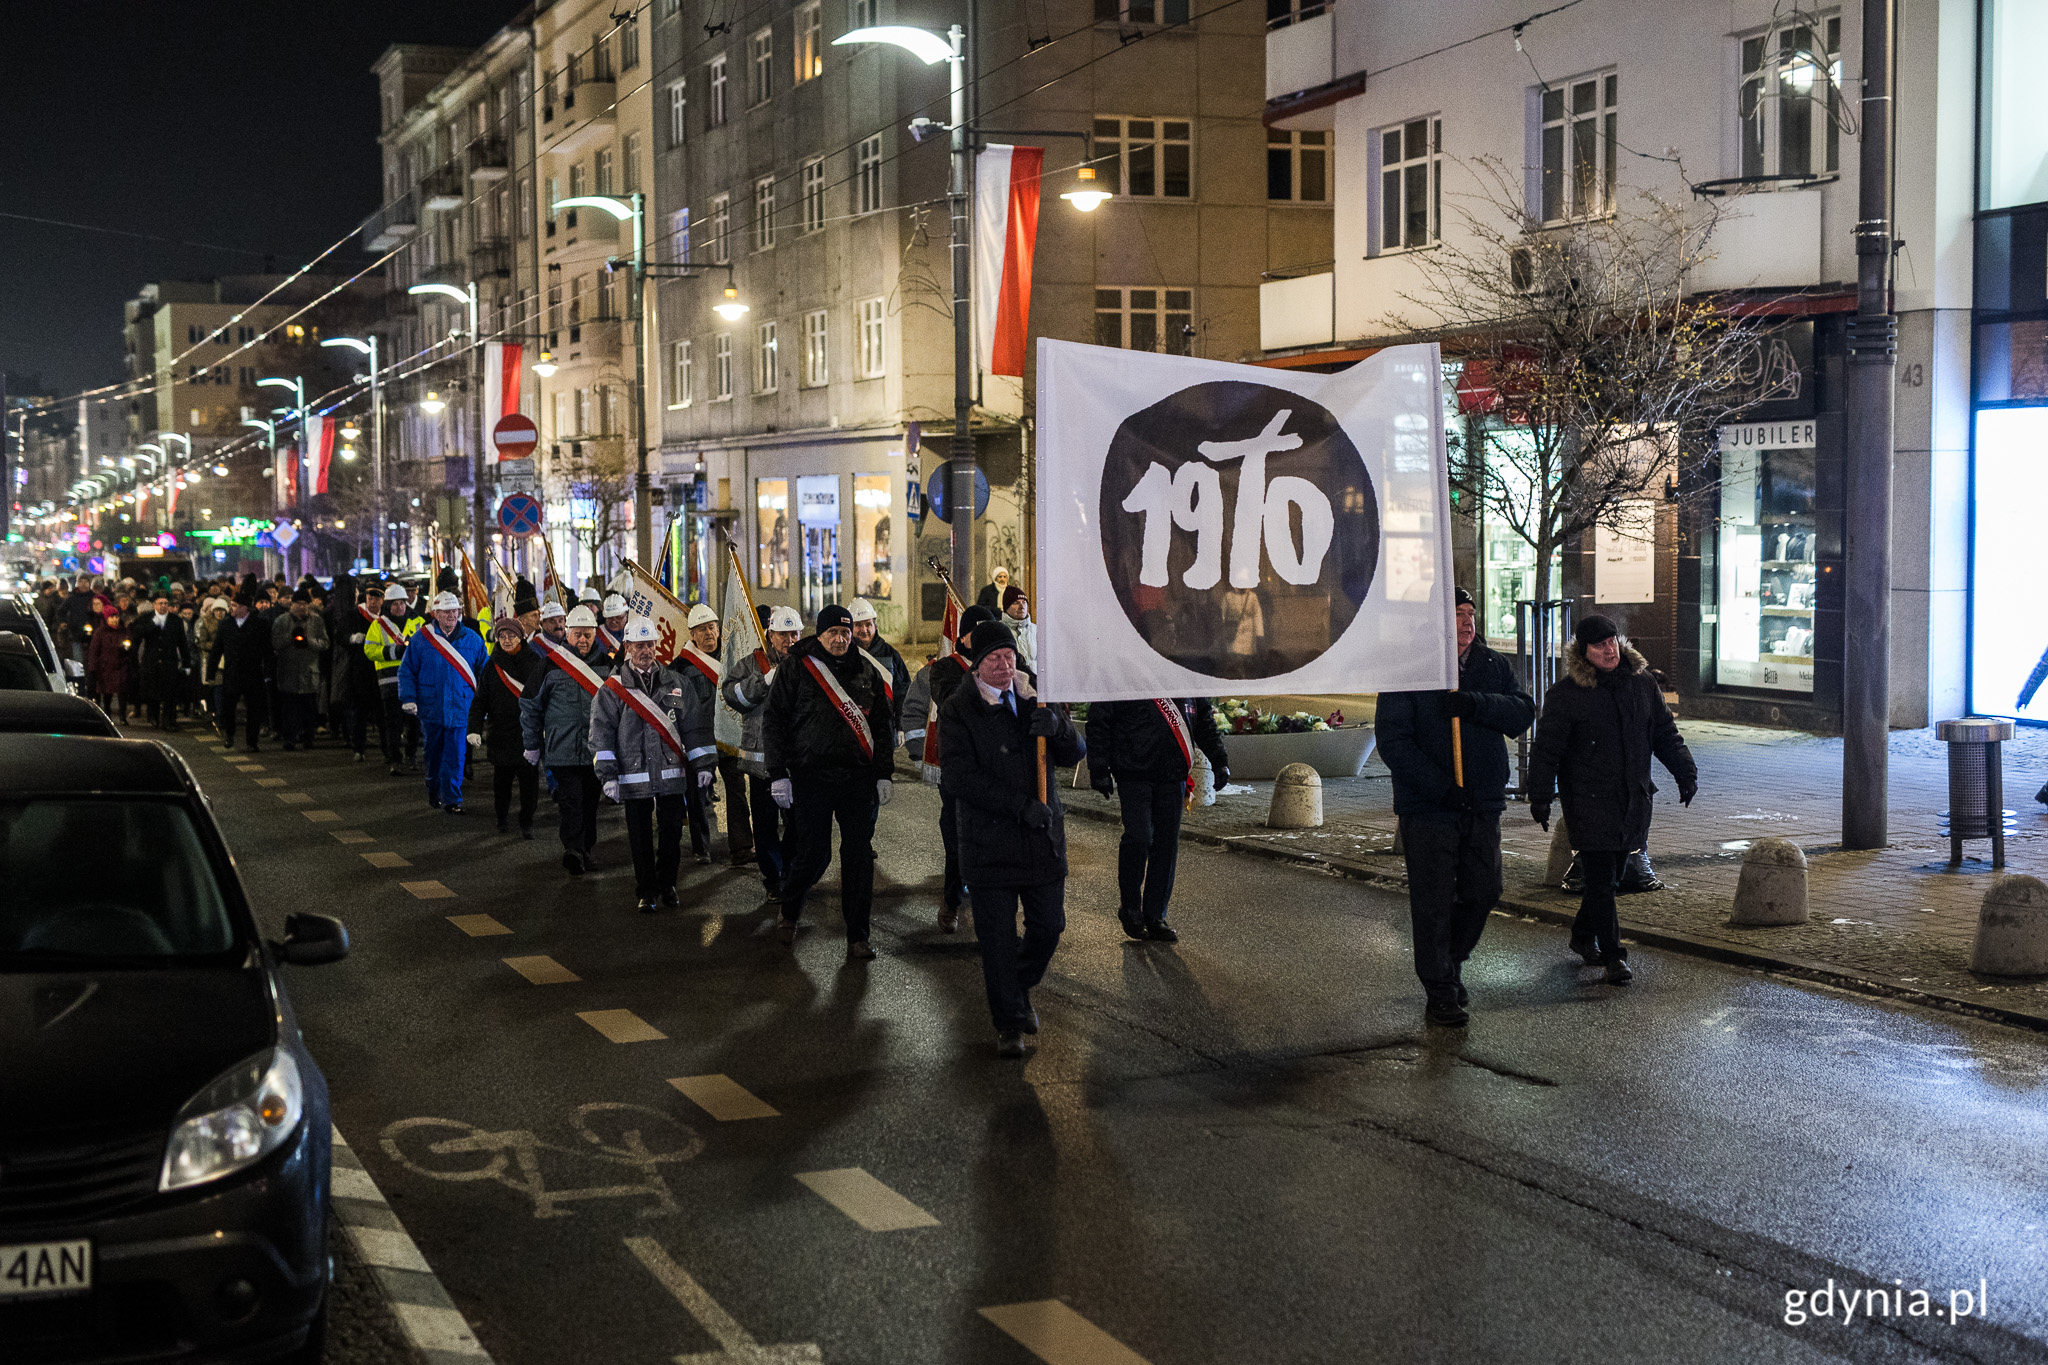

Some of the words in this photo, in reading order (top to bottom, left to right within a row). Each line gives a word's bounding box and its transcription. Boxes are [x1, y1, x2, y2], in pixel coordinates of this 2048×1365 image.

[1902, 364, 1923, 387] 43
[1731, 425, 1814, 447] JUBILER
[629, 590, 641, 610] 1976
[635, 594, 647, 615] 1981
